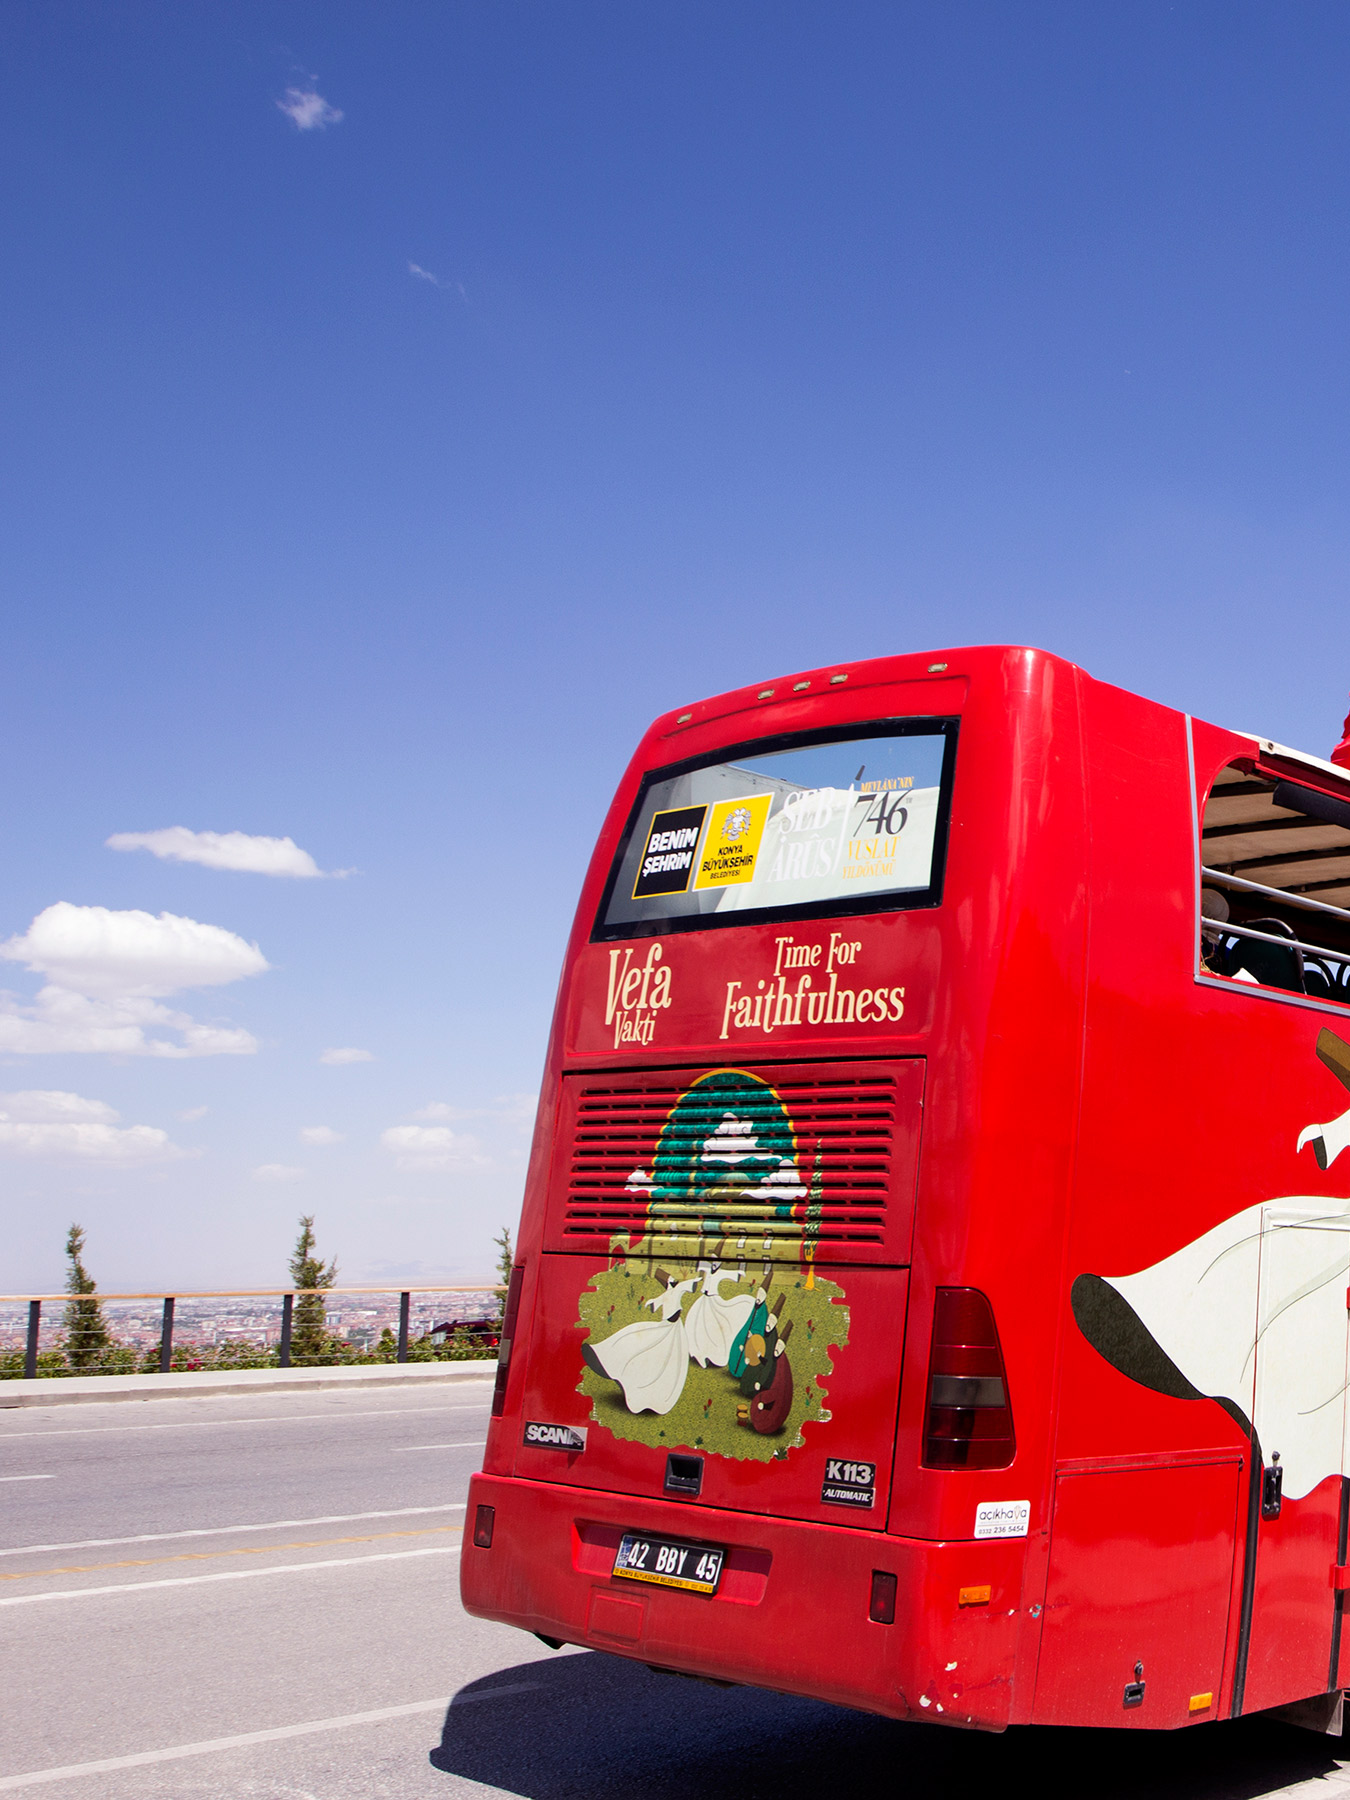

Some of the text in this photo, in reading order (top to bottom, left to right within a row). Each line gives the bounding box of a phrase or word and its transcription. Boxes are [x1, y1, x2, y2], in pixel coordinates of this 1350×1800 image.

[853, 788, 914, 838] 746
[718, 845, 743, 856] KONYA
[848, 836, 900, 860] VUSLAT
[773, 932, 862, 976] Time For
[605, 943, 672, 1025] Vefa
[719, 973, 905, 1040] Faithfulness
[614, 1009, 656, 1049] Vakti
[824, 1488, 871, 1502] AUTOMATIC
[993, 1526, 1007, 1534] 236
[627, 1542, 718, 1580] 42 BBY 45
